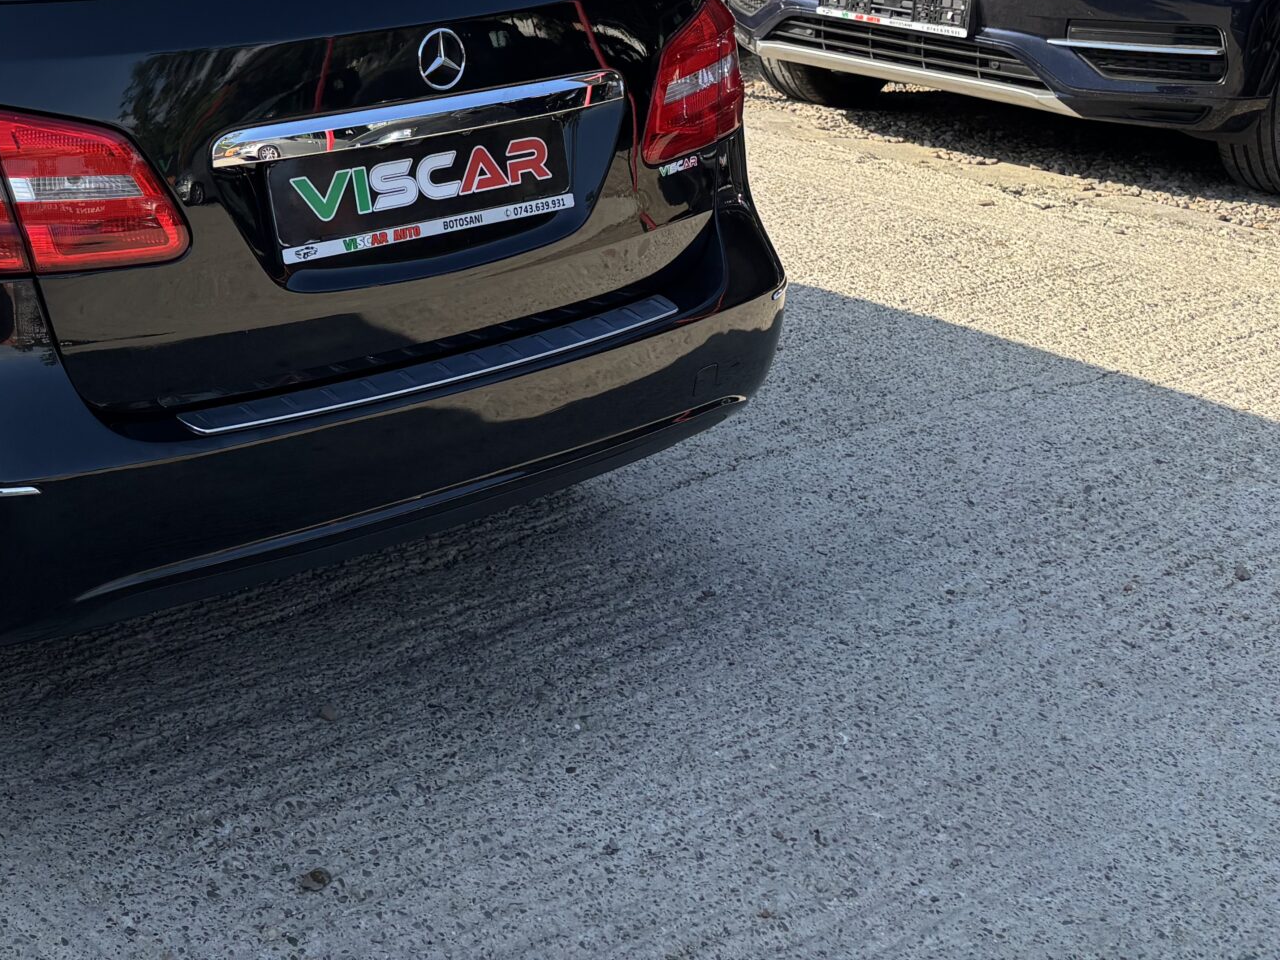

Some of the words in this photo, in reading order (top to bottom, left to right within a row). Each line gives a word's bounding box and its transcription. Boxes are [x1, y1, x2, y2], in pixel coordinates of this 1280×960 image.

[289, 136, 553, 222] VISCAR
[659, 155, 699, 178] VISCAR
[342, 231, 389, 252] VISCAR
[393, 225, 422, 242] AUTO
[443, 213, 483, 231] BOTOSANI
[513, 197, 566, 216] 0743.639.931
